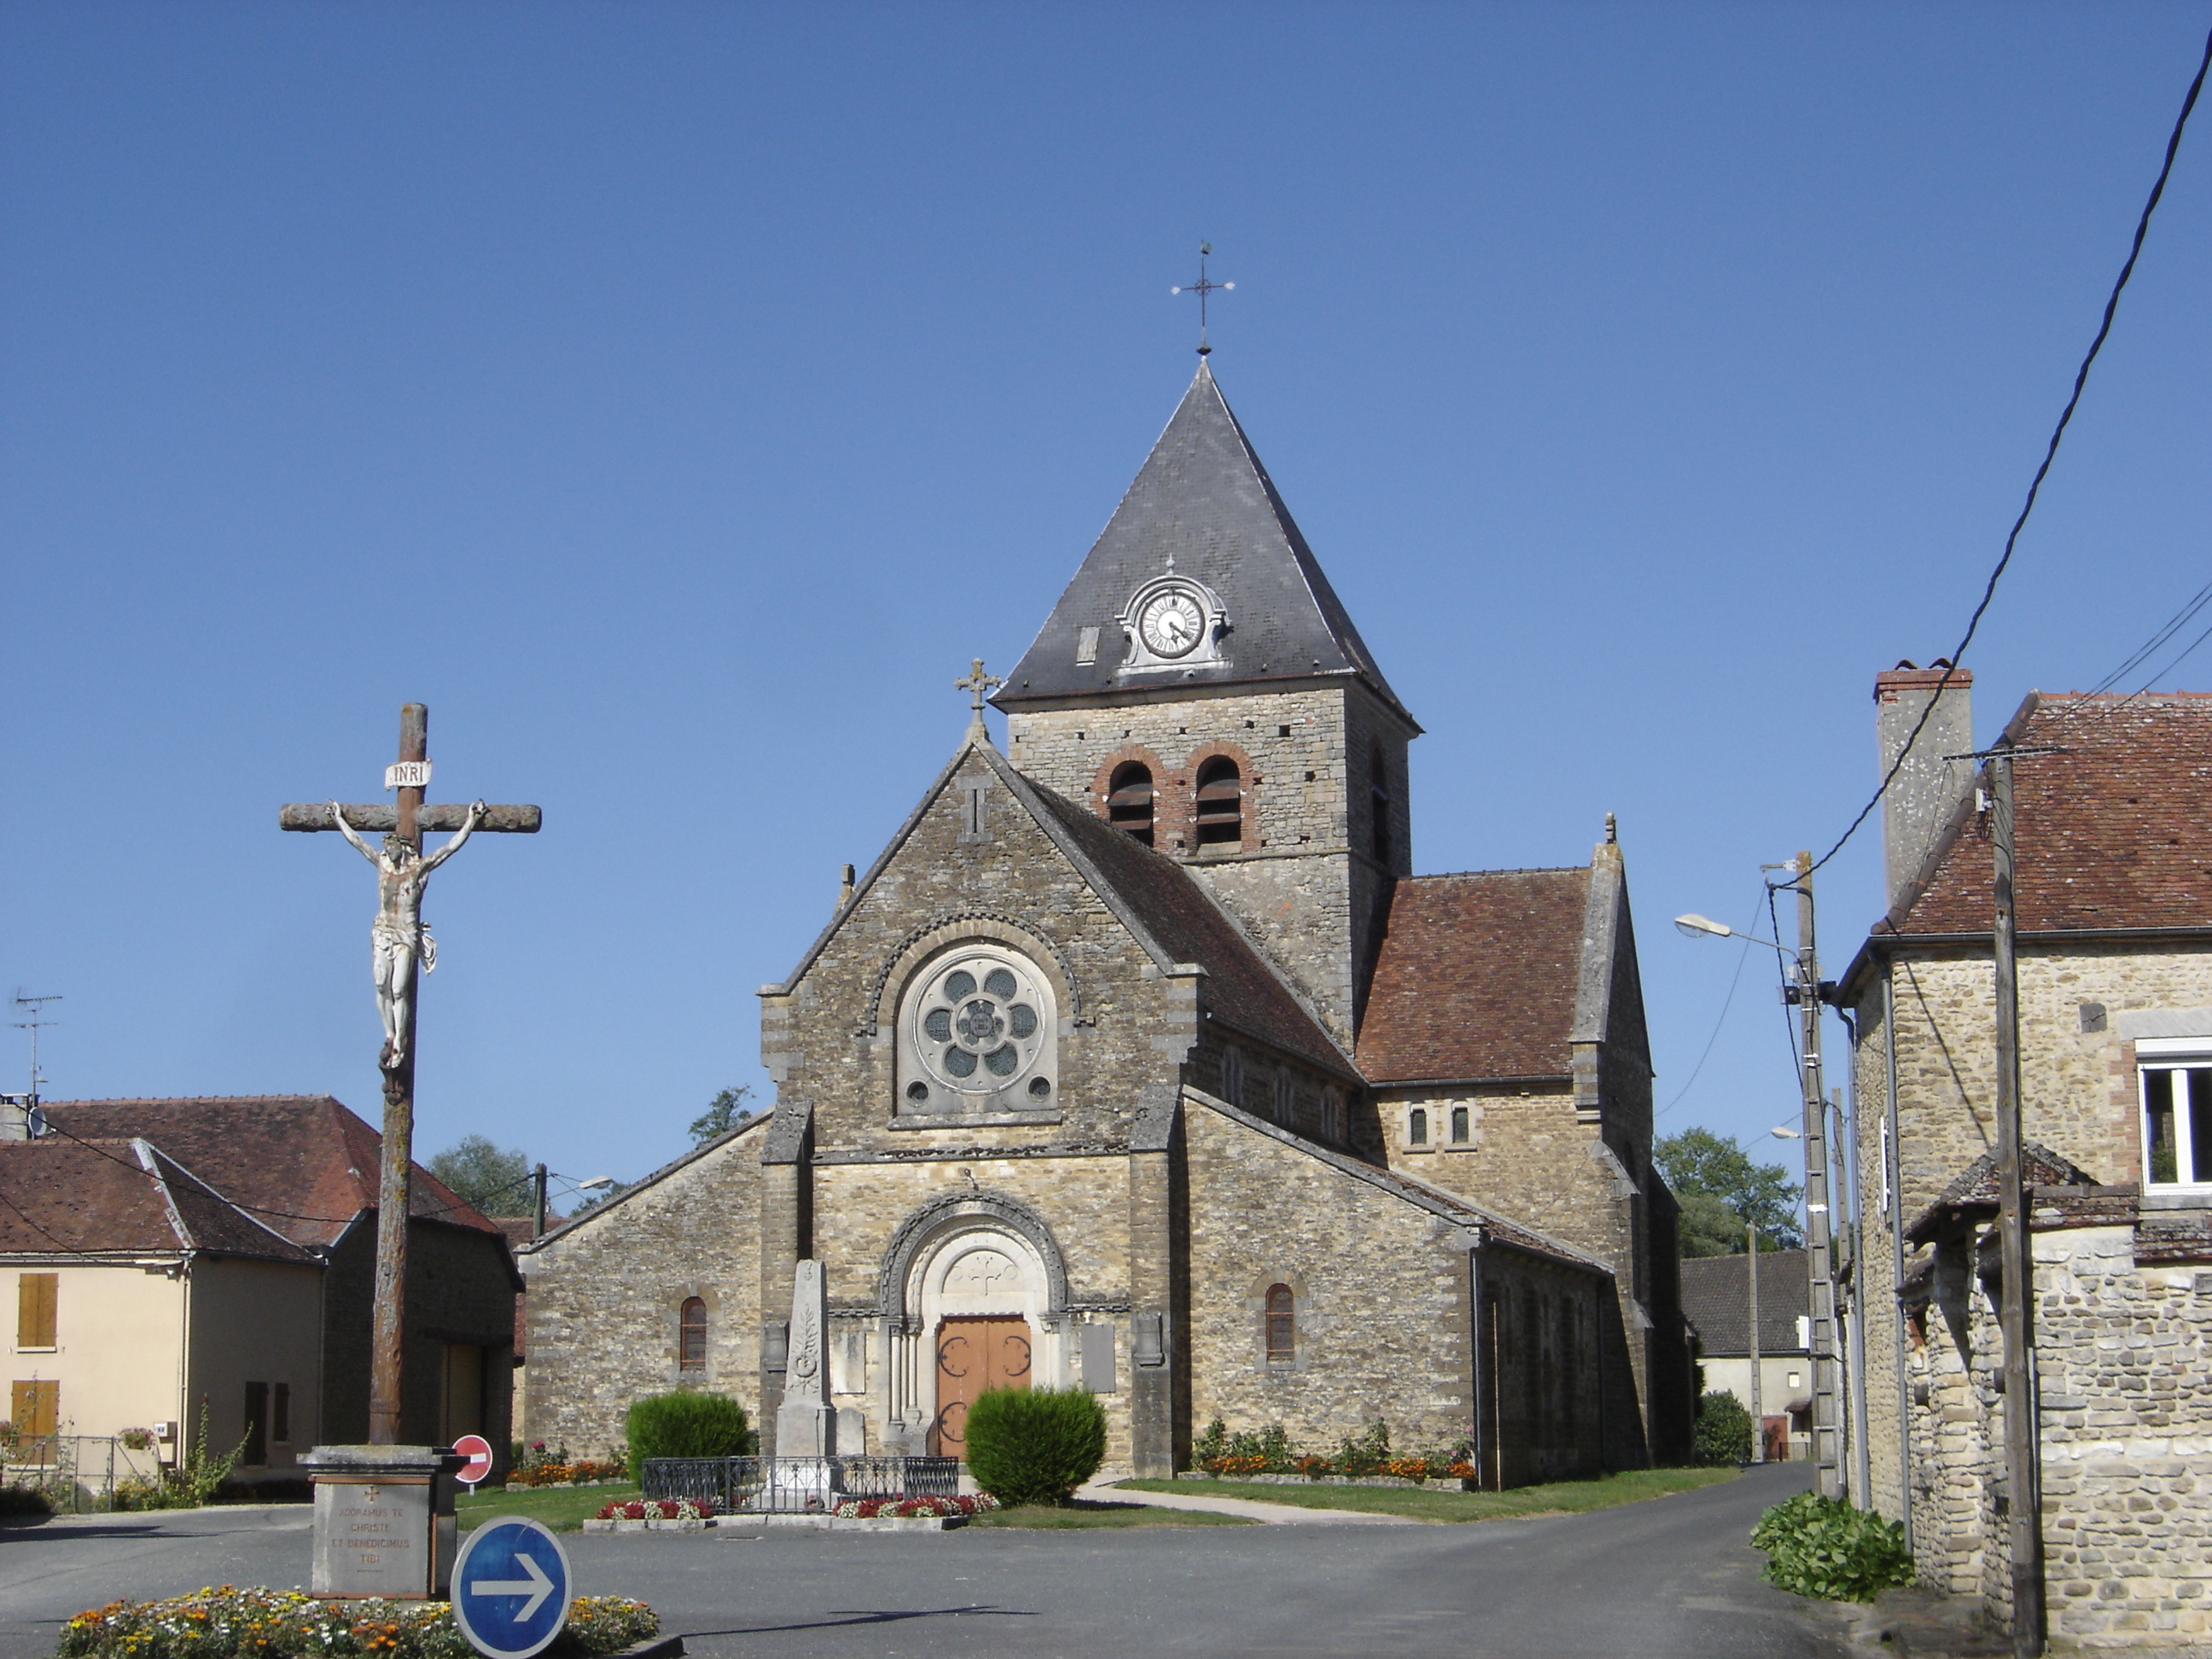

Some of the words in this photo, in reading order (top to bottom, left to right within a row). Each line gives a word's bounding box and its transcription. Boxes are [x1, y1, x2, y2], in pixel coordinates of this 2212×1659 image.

[394, 766, 423, 783] INRI
[339, 1508, 387, 1517] ADORAMUS
[392, 1508, 404, 1517] TE
[350, 1523, 390, 1532] CHRISTE
[331, 1539, 343, 1548] ET
[347, 1539, 410, 1548] BENEDICIMUS
[360, 1554, 380, 1563] TIBI
